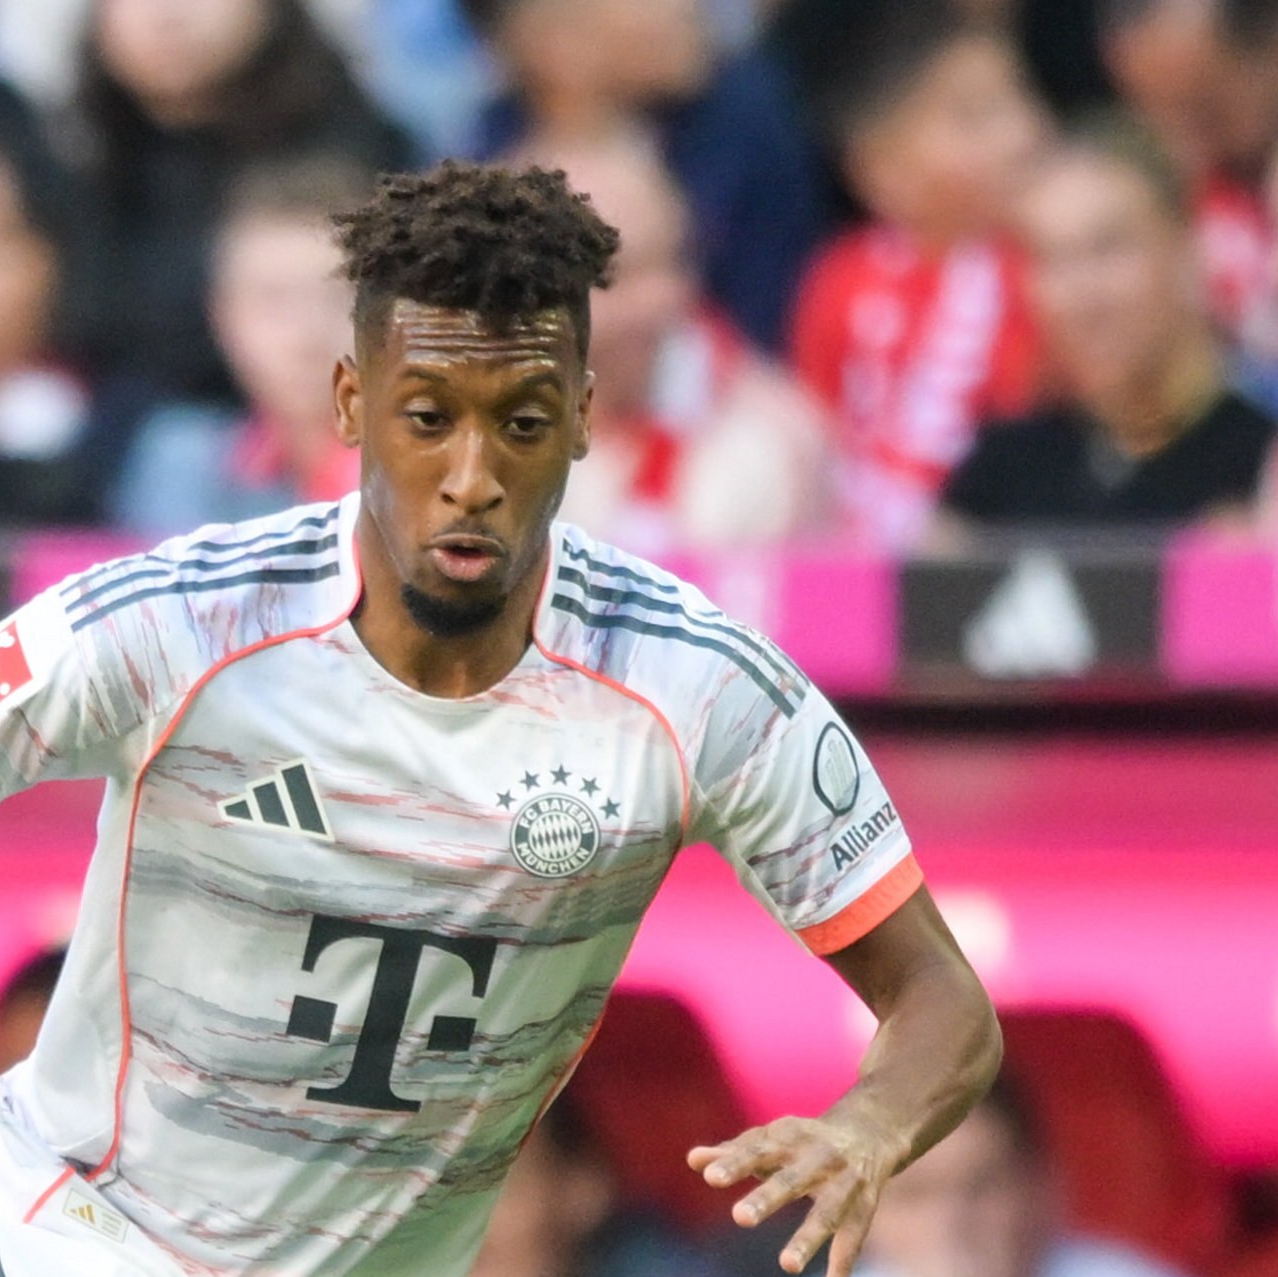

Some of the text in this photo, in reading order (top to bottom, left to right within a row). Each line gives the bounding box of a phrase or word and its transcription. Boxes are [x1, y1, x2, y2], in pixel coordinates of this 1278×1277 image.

[519, 799, 594, 834] FC BAYERN
[830, 802, 897, 871] Allianz
[286, 914, 497, 1113] T
